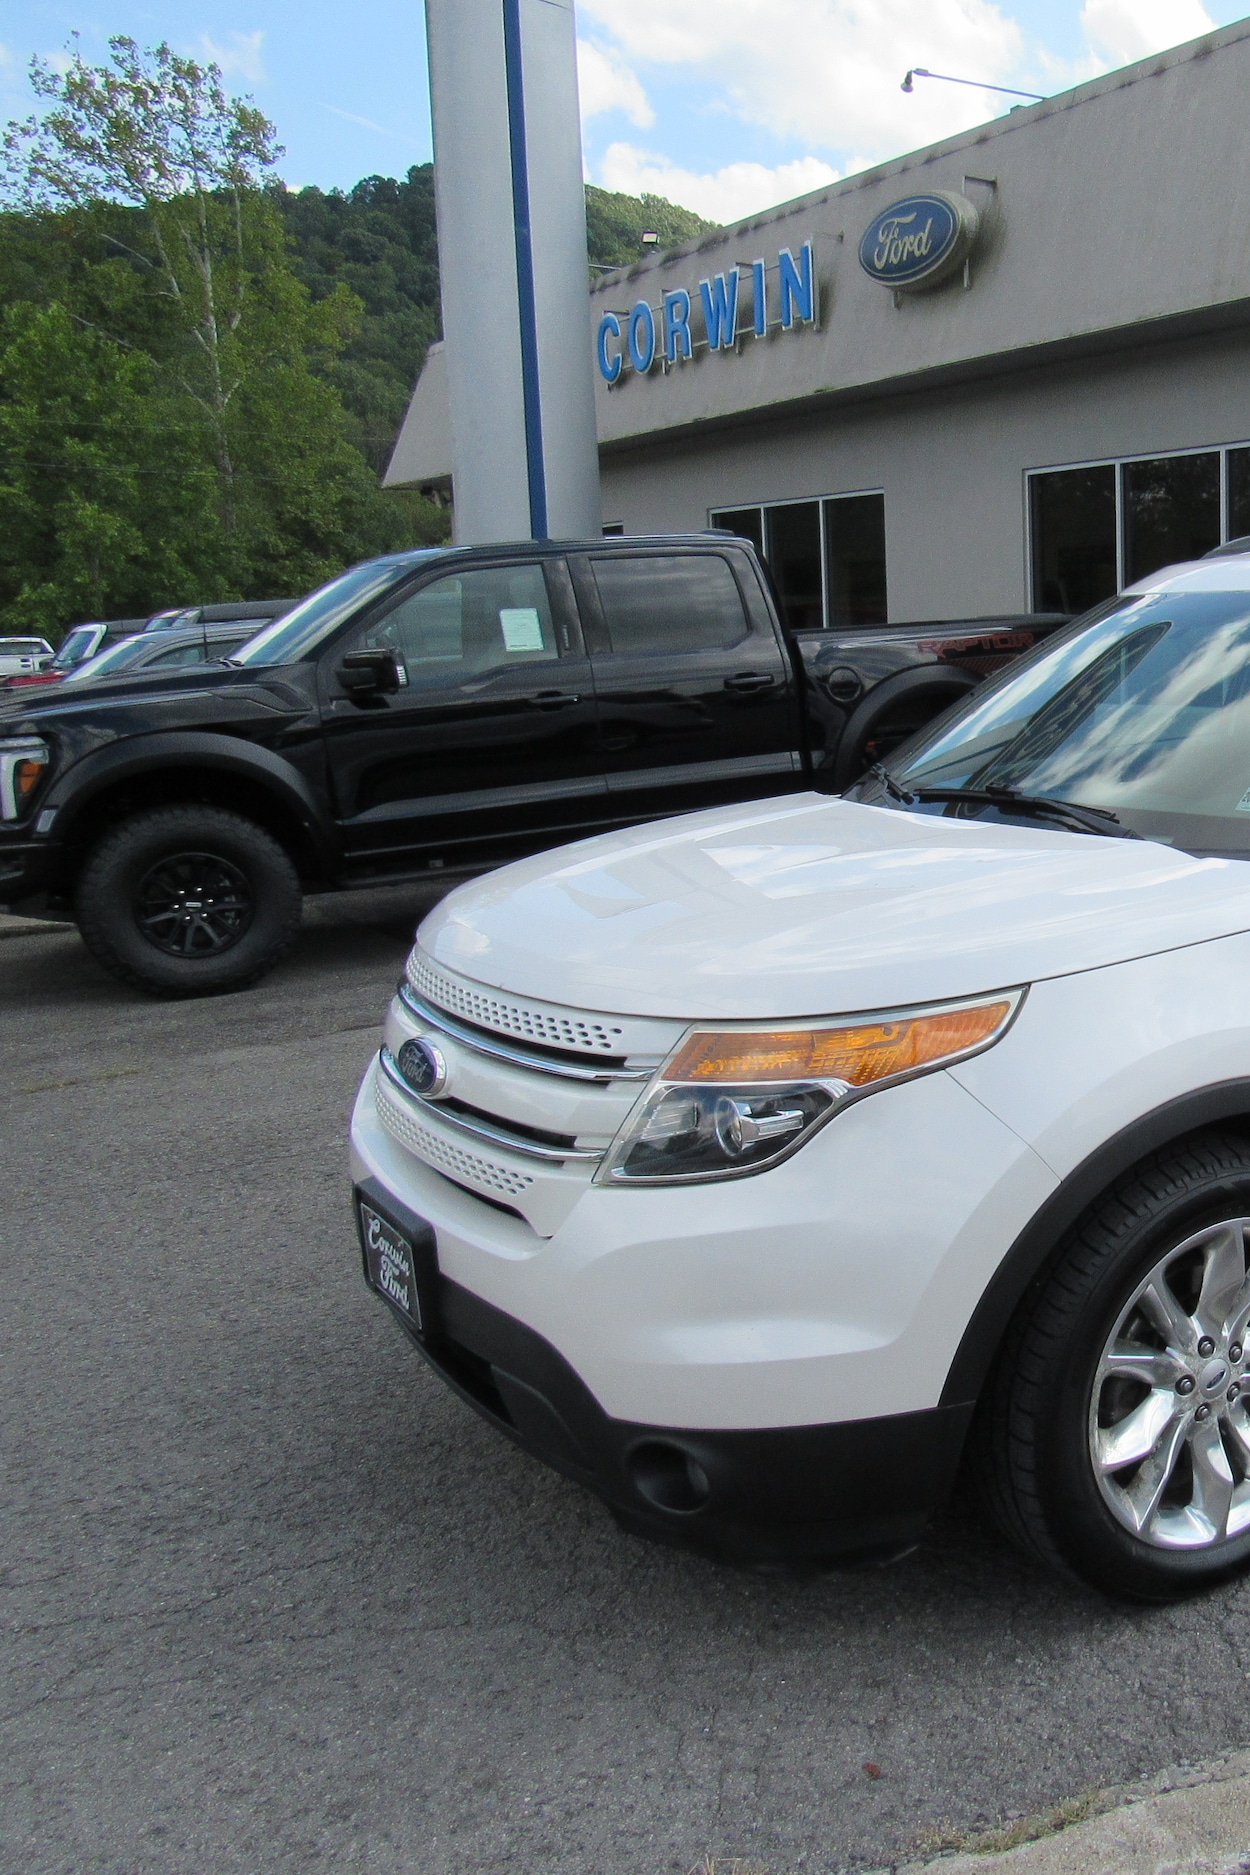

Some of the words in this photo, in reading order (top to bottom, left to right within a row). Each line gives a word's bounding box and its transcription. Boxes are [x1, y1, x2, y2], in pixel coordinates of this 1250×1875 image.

[874, 211, 933, 270] Ford
[597, 240, 816, 385] CORWIN
[916, 633, 1035, 658] RAPTOR
[403, 1045, 428, 1083] Ford
[368, 1218, 410, 1277] Corwin
[380, 1254, 410, 1311] Ford
